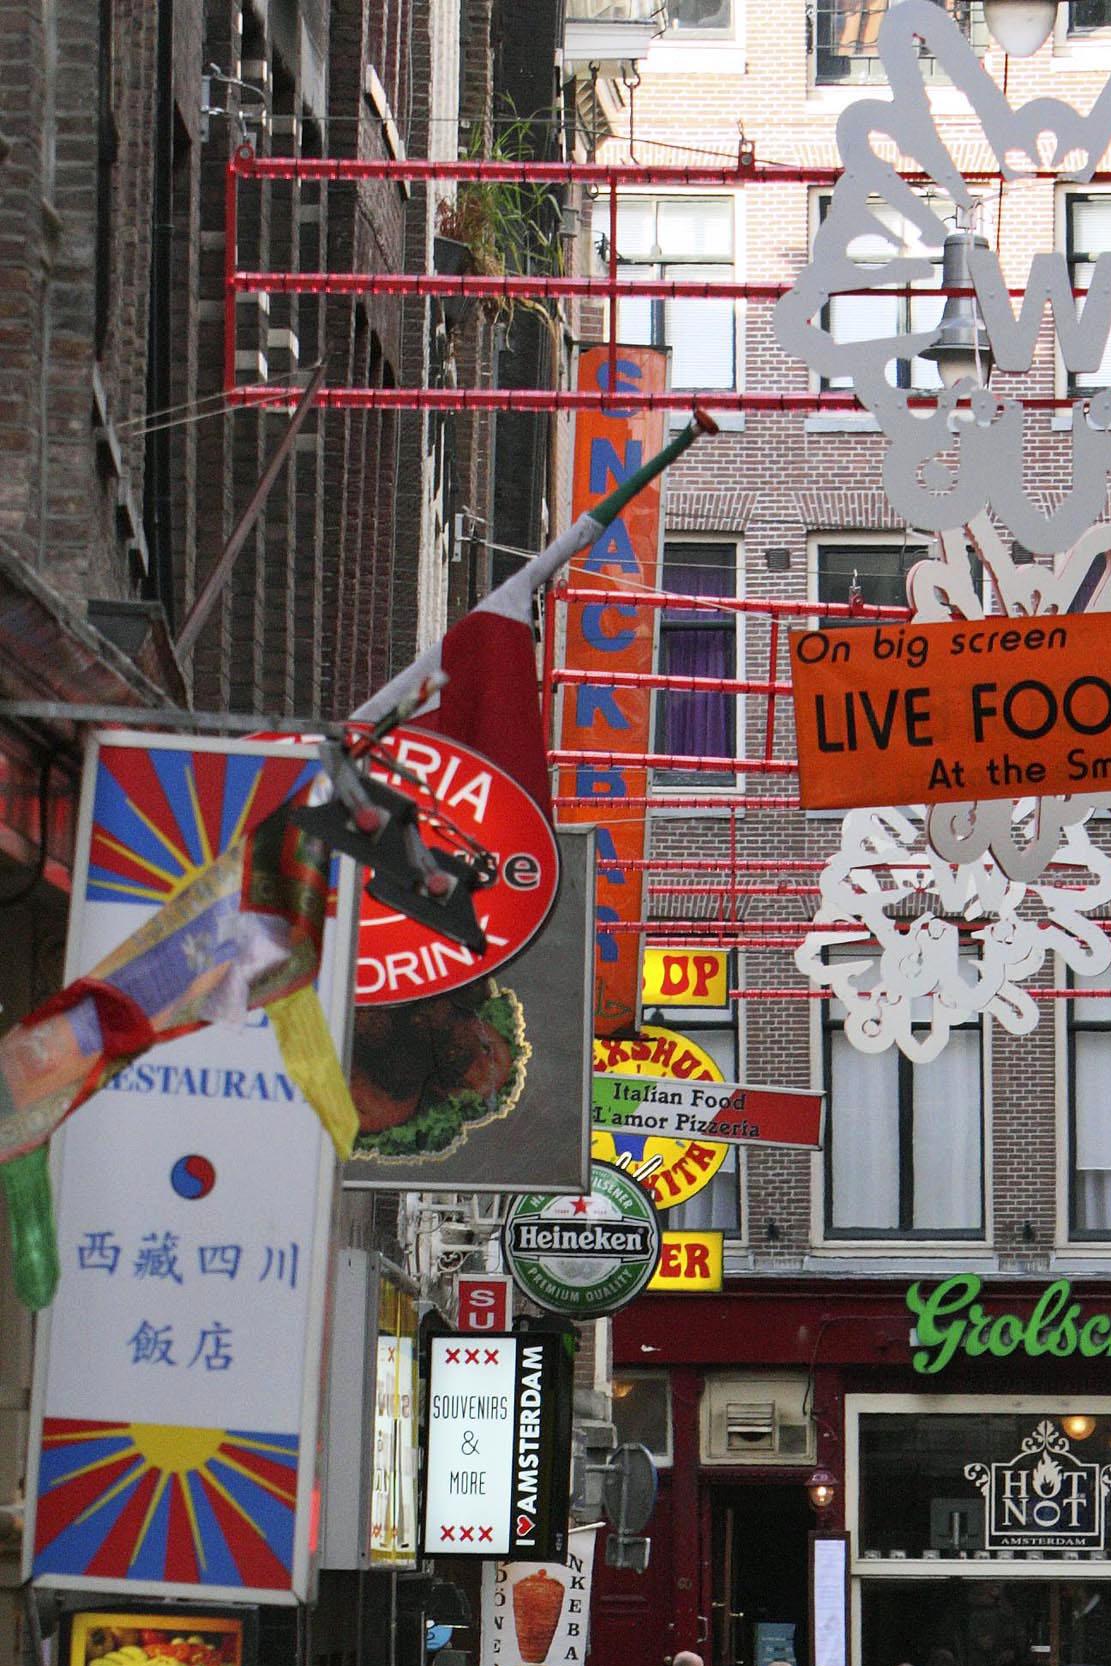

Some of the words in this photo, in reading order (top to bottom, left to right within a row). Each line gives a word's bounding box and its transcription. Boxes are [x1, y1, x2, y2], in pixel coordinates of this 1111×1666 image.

[797, 632, 852, 664] On
[873, 629, 929, 668] big
[950, 626, 1067, 655] screen
[816, 687, 934, 753] LIVE
[927, 758, 965, 790] At
[987, 755, 1047, 786] the
[100, 1063, 308, 1103] ESTAURAN
[613, 1082, 690, 1106] Italian
[691, 1089, 747, 1111] Food
[676, 1114, 760, 1138] Pizzeria
[591, 1177, 634, 1210] ILSENER
[518, 1225, 643, 1251] Heineken
[77, 1230, 300, 1290] 西藏四川
[528, 1267, 581, 1302] PREMIUM
[585, 1268, 633, 1301] QUALITY
[127, 1319, 235, 1372] 飯店
[433, 1394, 508, 1420] SOUVENIRS
[461, 1430, 480, 1455] &
[515, 1345, 543, 1514] AMSTERDAM
[450, 1471, 487, 1495] MORE
[1002, 1463, 1088, 1499] HOT
[1002, 1499, 1087, 1527] NOT
[1000, 1537, 1087, 1546] AMSTERDAM
